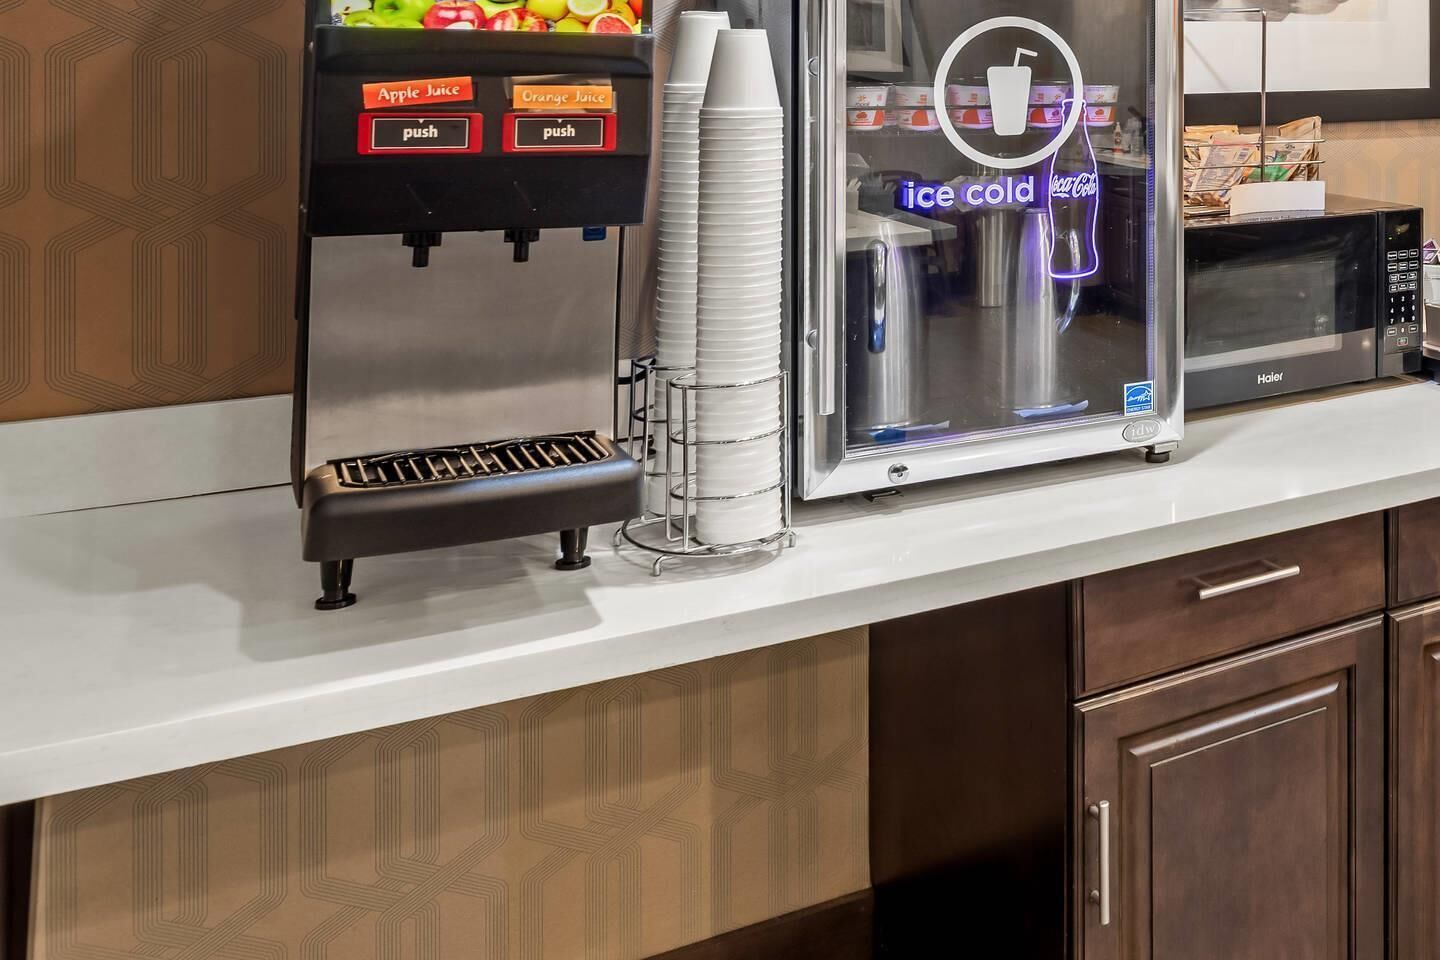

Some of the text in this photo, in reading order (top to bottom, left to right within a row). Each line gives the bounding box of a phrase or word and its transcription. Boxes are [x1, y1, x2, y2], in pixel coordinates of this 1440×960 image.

[377, 84, 461, 104] Apple Juice
[521, 91, 606, 106] Orange Juice
[402, 125, 439, 142] push
[543, 124, 576, 140] push
[907, 176, 1035, 209] ice cold
[1257, 371, 1284, 385] Haier
